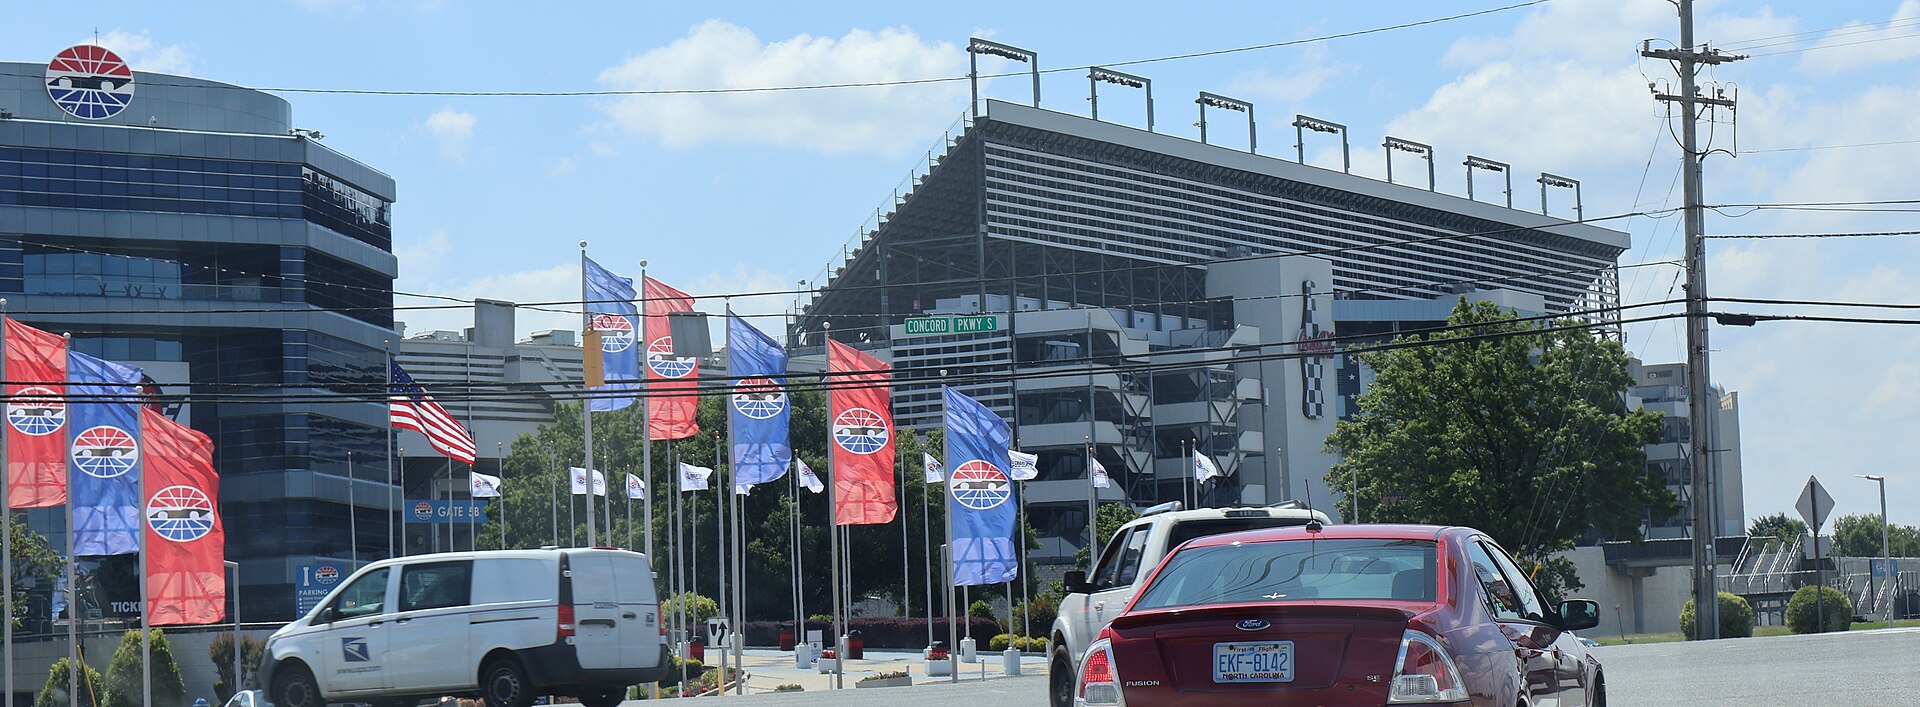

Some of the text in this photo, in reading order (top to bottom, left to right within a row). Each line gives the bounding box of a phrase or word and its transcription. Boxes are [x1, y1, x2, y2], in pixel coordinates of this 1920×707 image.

[907, 317, 993, 333] CONCORD PKWY S
[437, 506, 464, 517] GATE
[1242, 619, 1262, 628] Ford
[1219, 653, 1288, 673] EKF-8142
[1222, 672, 1248, 680] NORTH
